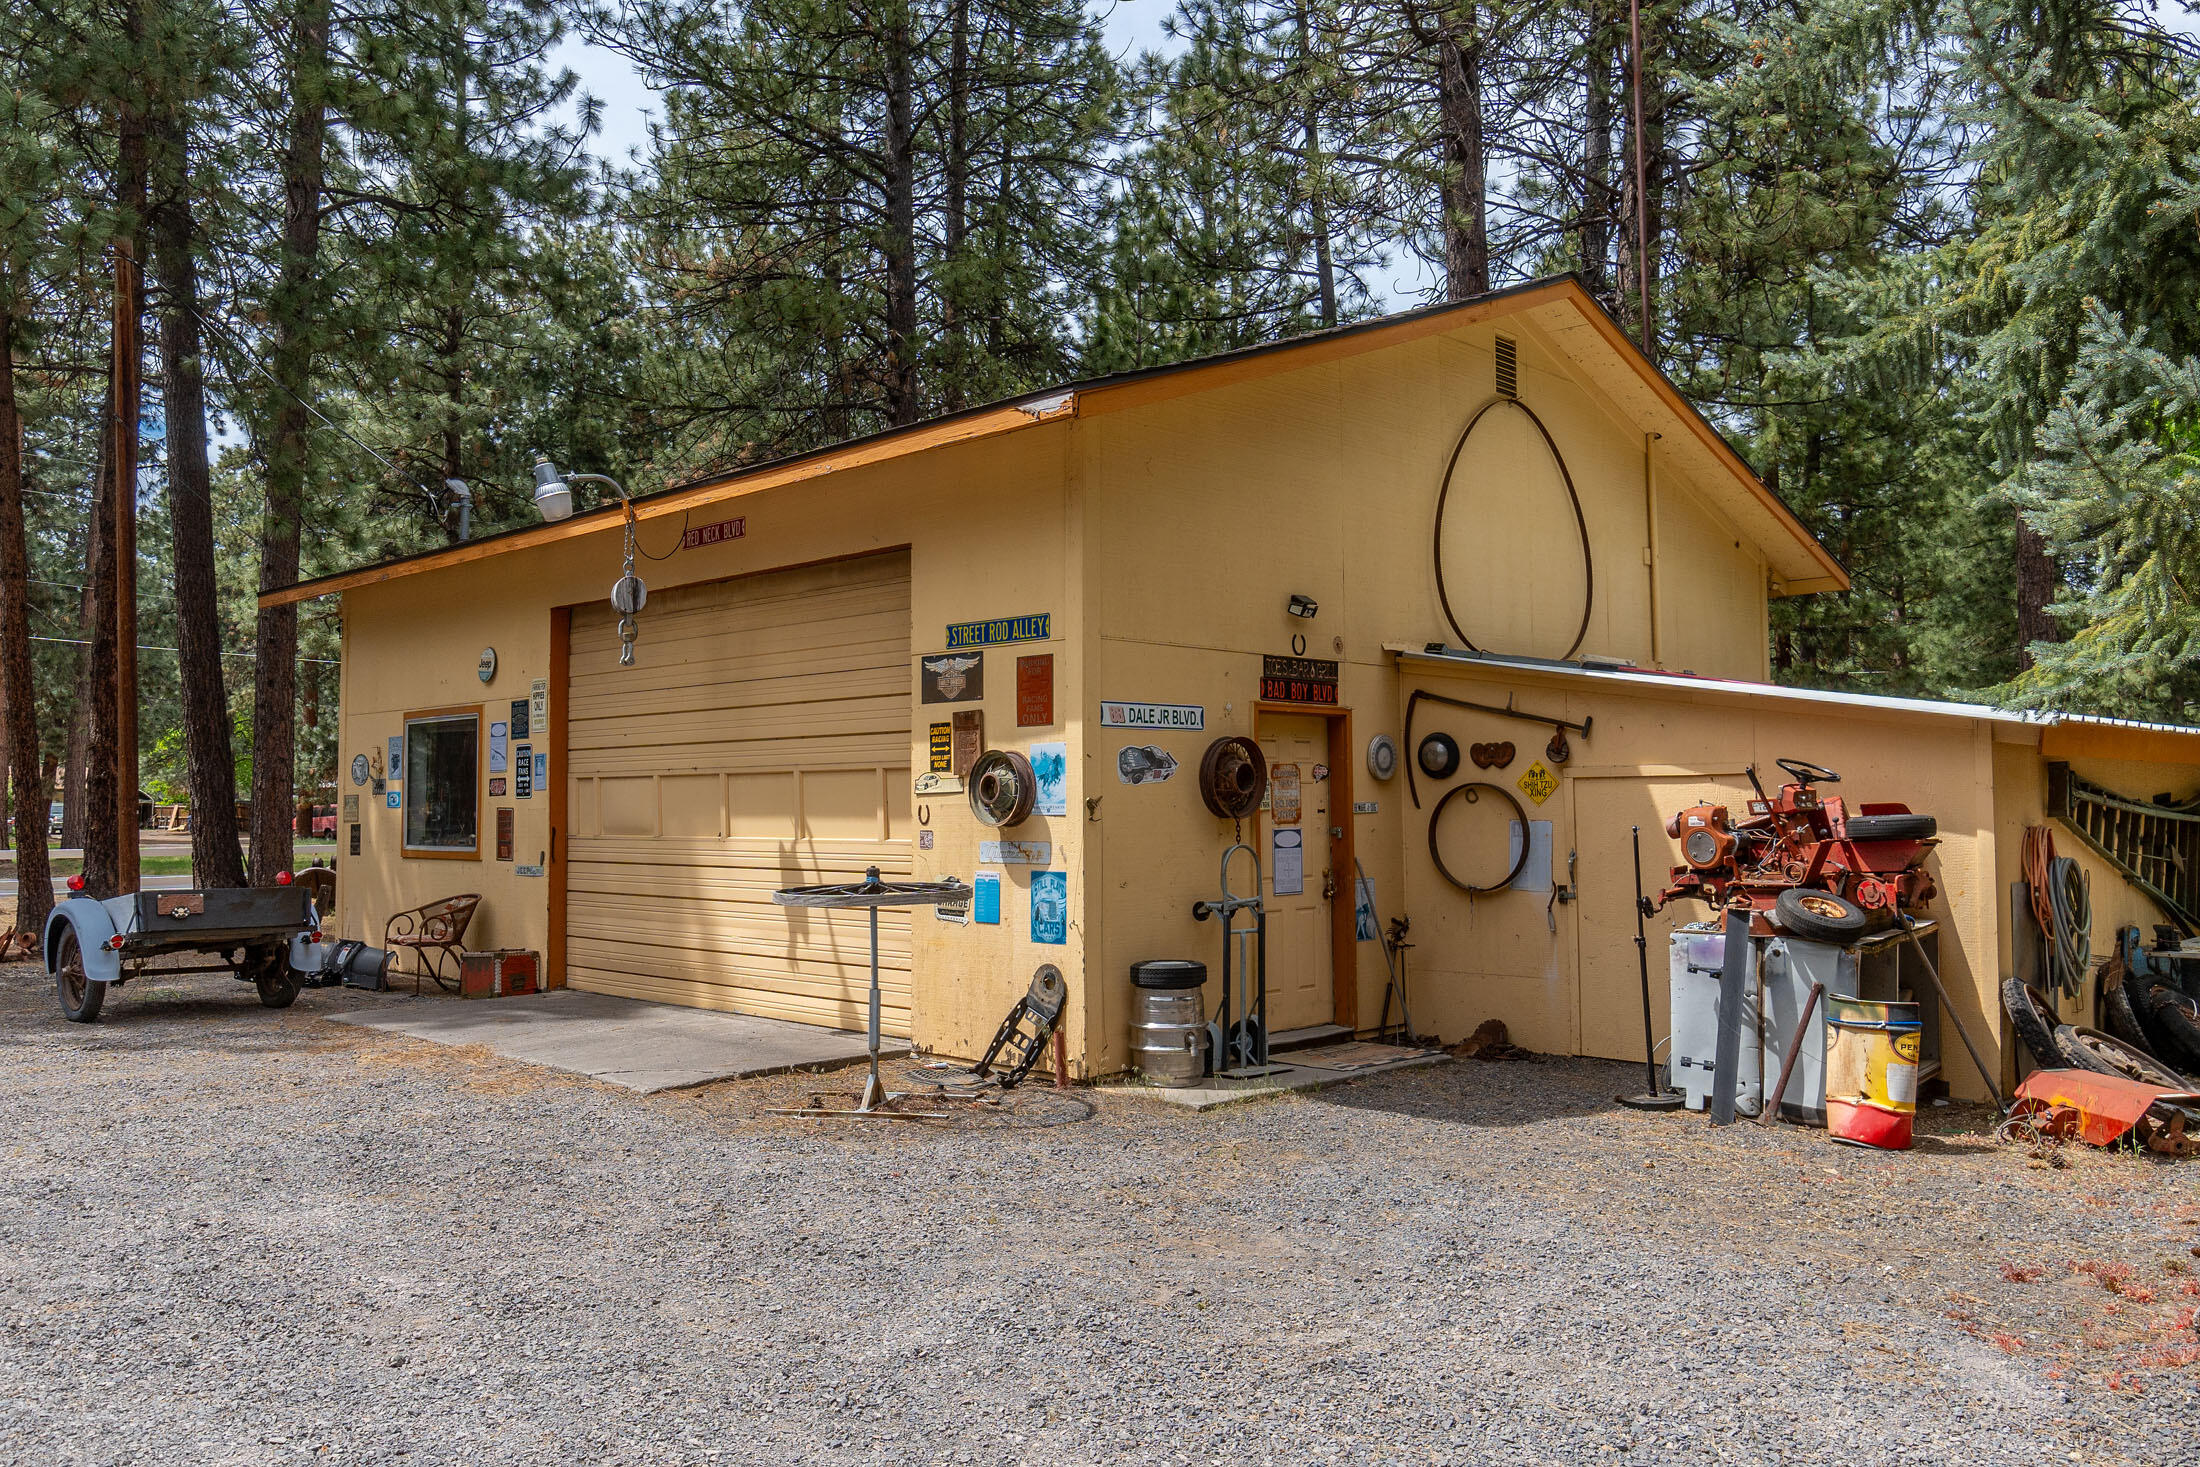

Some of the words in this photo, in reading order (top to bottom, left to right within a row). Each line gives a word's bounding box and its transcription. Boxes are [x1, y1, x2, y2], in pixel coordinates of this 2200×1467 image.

[687, 530, 699, 546] RED
[703, 525, 720, 543] NECK
[723, 520, 740, 539] BLVD
[952, 624, 985, 645] STREET
[989, 621, 1008, 641] ROD
[1012, 617, 1044, 639] ALLEY
[1267, 680, 1285, 698] BAD
[1291, 682, 1308, 700] BOY
[1313, 684, 1333, 702] BLVD
[1022, 694, 1048, 704] RACING
[1026, 704, 1044, 712] FANS
[1022, 713, 1048, 724] ONLY
[1128, 707, 1155, 724] DALE
[1158, 709, 1170, 725] JR
[1172, 710, 1199, 726] BLVD.
[931, 726, 951, 735] CAUTION
[931, 735, 950, 743] RACING
[518, 758, 529, 767] RACE
[933, 760, 948, 768] NONE
[1523, 780, 1538, 790] SHIH
[1540, 780, 1553, 790] TZU
[1529, 788, 1547, 797] XING
[1034, 878, 1048, 896] STILL
[1038, 922, 1060, 935] CARS
